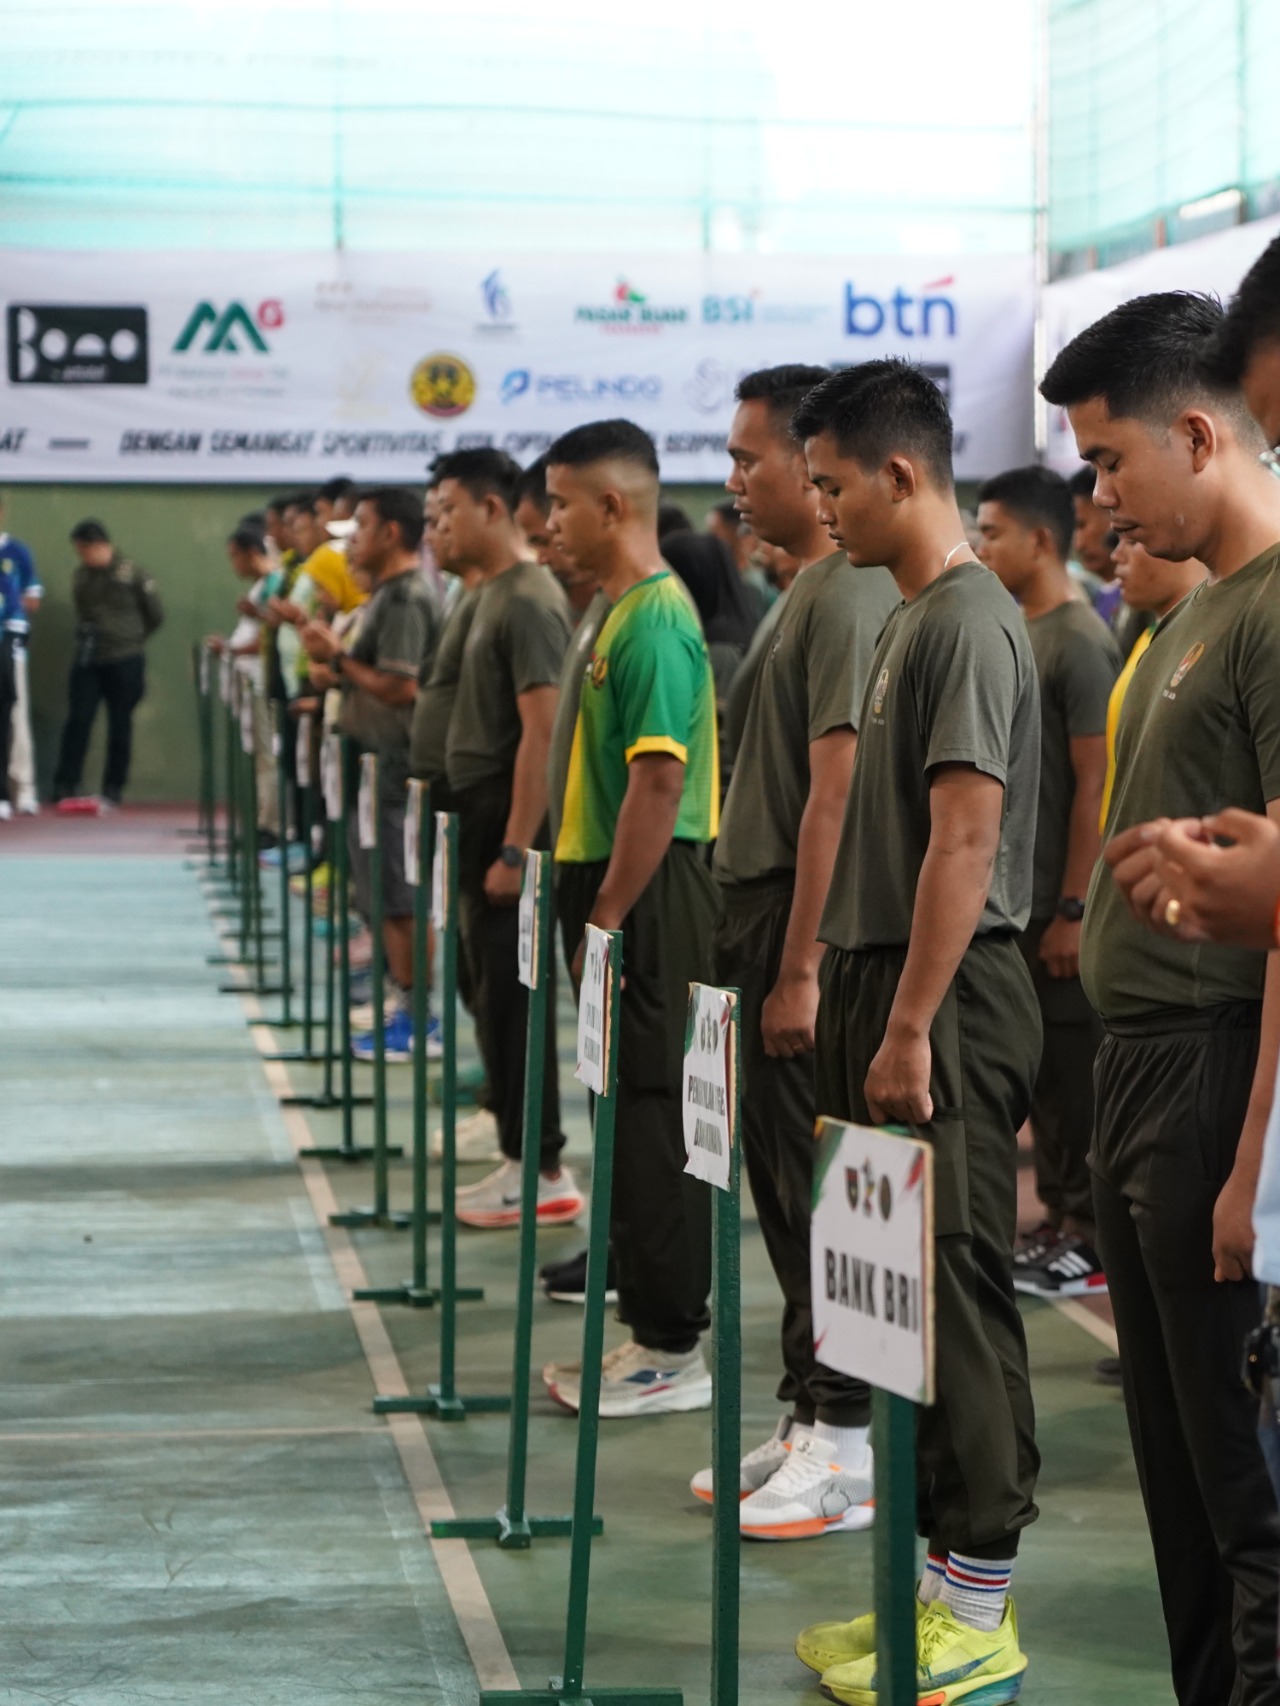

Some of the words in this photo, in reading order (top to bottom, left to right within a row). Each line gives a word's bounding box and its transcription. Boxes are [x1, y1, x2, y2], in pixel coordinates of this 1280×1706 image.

[845, 276, 956, 337] btn
[119, 429, 202, 454] DENGAN
[209, 430, 316, 456] SEMANGAT
[322, 431, 445, 456] SPORTIVITAS
[824, 1248, 877, 1318] BANK
[883, 1266, 919, 1334] BRI
